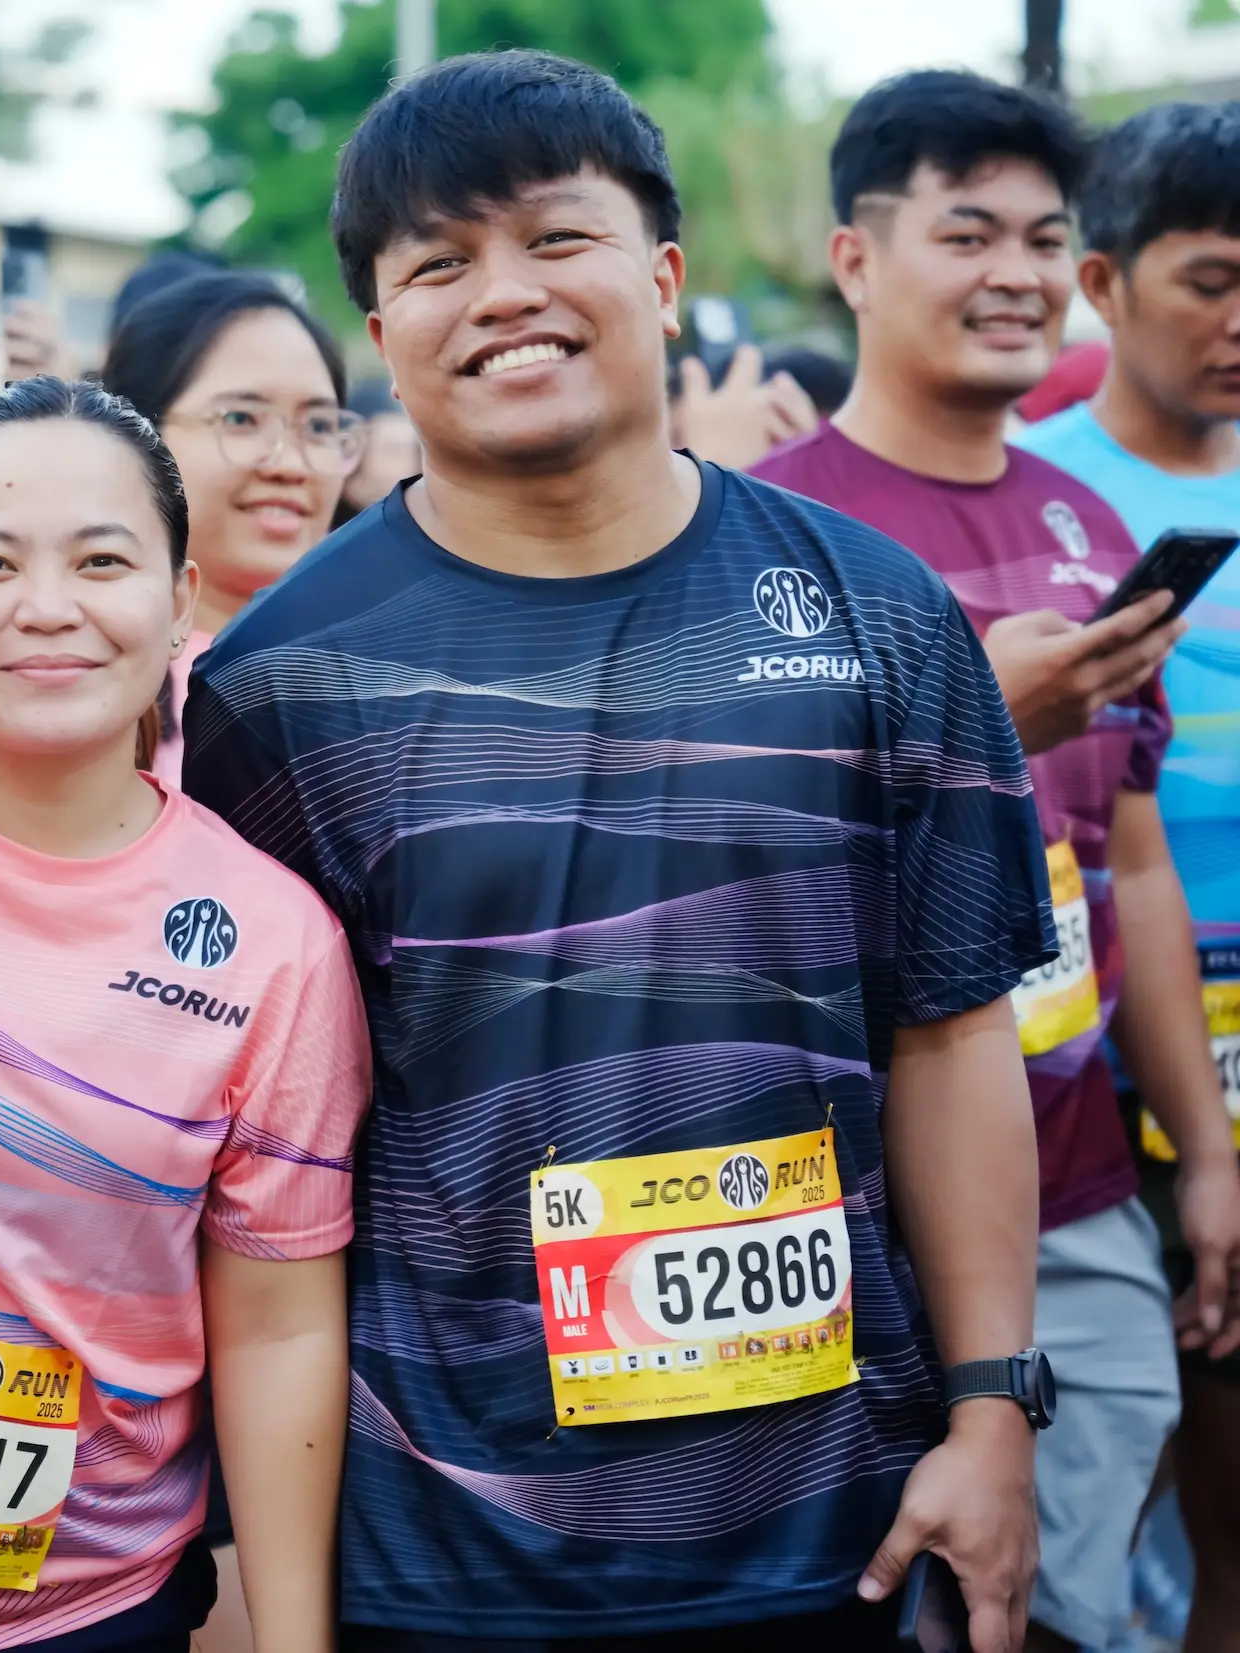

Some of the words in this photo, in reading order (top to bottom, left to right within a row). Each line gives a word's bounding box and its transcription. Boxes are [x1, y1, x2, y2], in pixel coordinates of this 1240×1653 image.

[108, 970, 251, 1028] JCORUN
[630, 1174, 711, 1208] JCO
[774, 1154, 825, 1190] RUN
[802, 1185, 825, 1204] 2025
[545, 1188, 588, 1229] 5K
[549, 1264, 592, 1320] M
[654, 1228, 837, 1325] 52866
[562, 1324, 589, 1338] MALE
[7, 1369, 70, 1399] RUN
[36, 1402, 64, 1419] 2025
